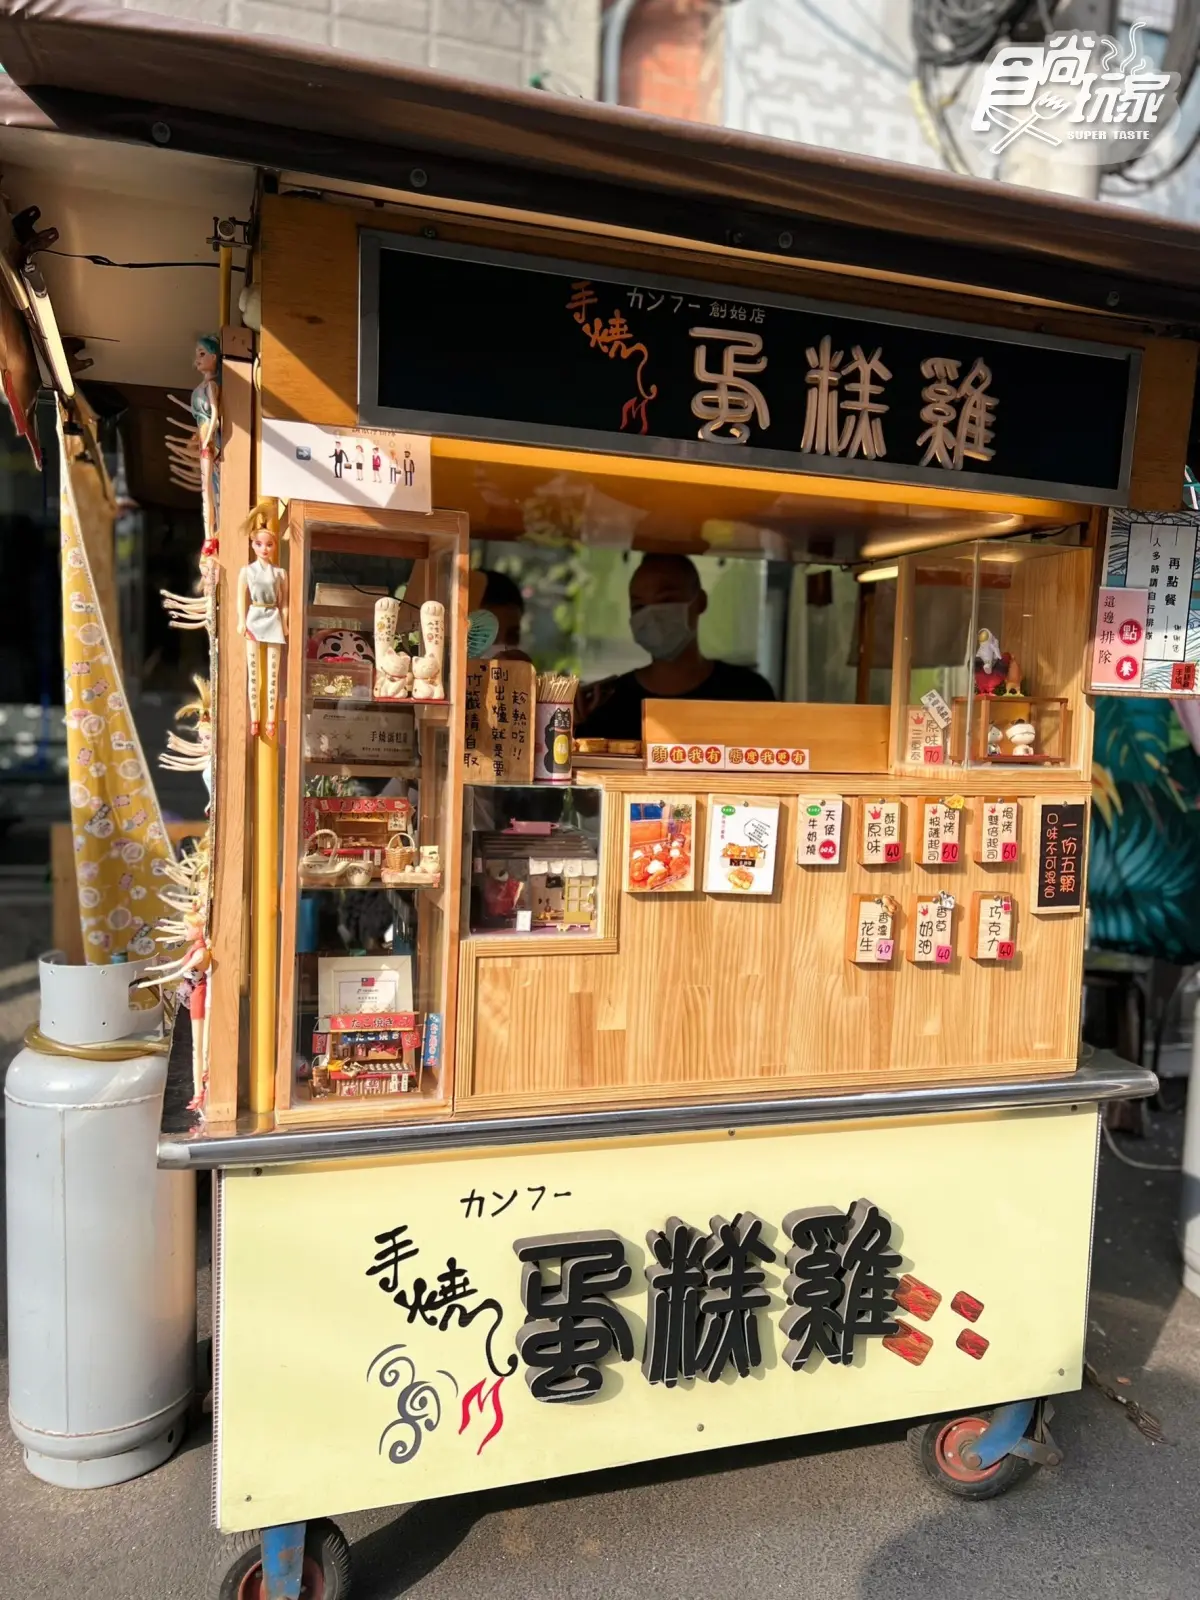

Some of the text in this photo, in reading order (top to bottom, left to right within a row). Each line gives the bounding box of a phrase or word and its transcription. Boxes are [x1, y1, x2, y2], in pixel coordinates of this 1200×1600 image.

[627, 287, 766, 324] カンフー 創始店
[689, 326, 999, 470] 蛋糕雞
[1164, 557, 1181, 606] 再點餐
[1098, 596, 1116, 665] 這邊排隊
[1120, 624, 1138, 677] 點餐
[491, 667, 509, 776] 剛出爐就是要
[925, 719, 939, 745] 原味
[652, 745, 721, 764] 顏值我有
[926, 750, 939, 763] 70
[806, 818, 818, 855] 牛奶燒
[824, 810, 836, 836] 天使
[867, 822, 882, 854] 原味
[884, 813, 895, 836] 酥皮
[987, 815, 999, 860] 雙倍起司
[887, 845, 900, 858] 40
[942, 844, 958, 860] 60
[1003, 844, 1017, 860] 60
[1044, 813, 1058, 899] 口味不可混合
[1060, 823, 1078, 892] 一份五顆
[935, 906, 947, 932] 香草
[988, 906, 1002, 952] 巧克力
[859, 921, 875, 952] 花生
[878, 944, 891, 954] 40
[918, 921, 934, 955] 奶油
[1001, 945, 1012, 957] 40
[938, 948, 950, 960] 40
[460, 1186, 572, 1218] カンフー
[365, 1224, 519, 1377] 手燒
[512, 1196, 904, 1404] 蛋糕雞
